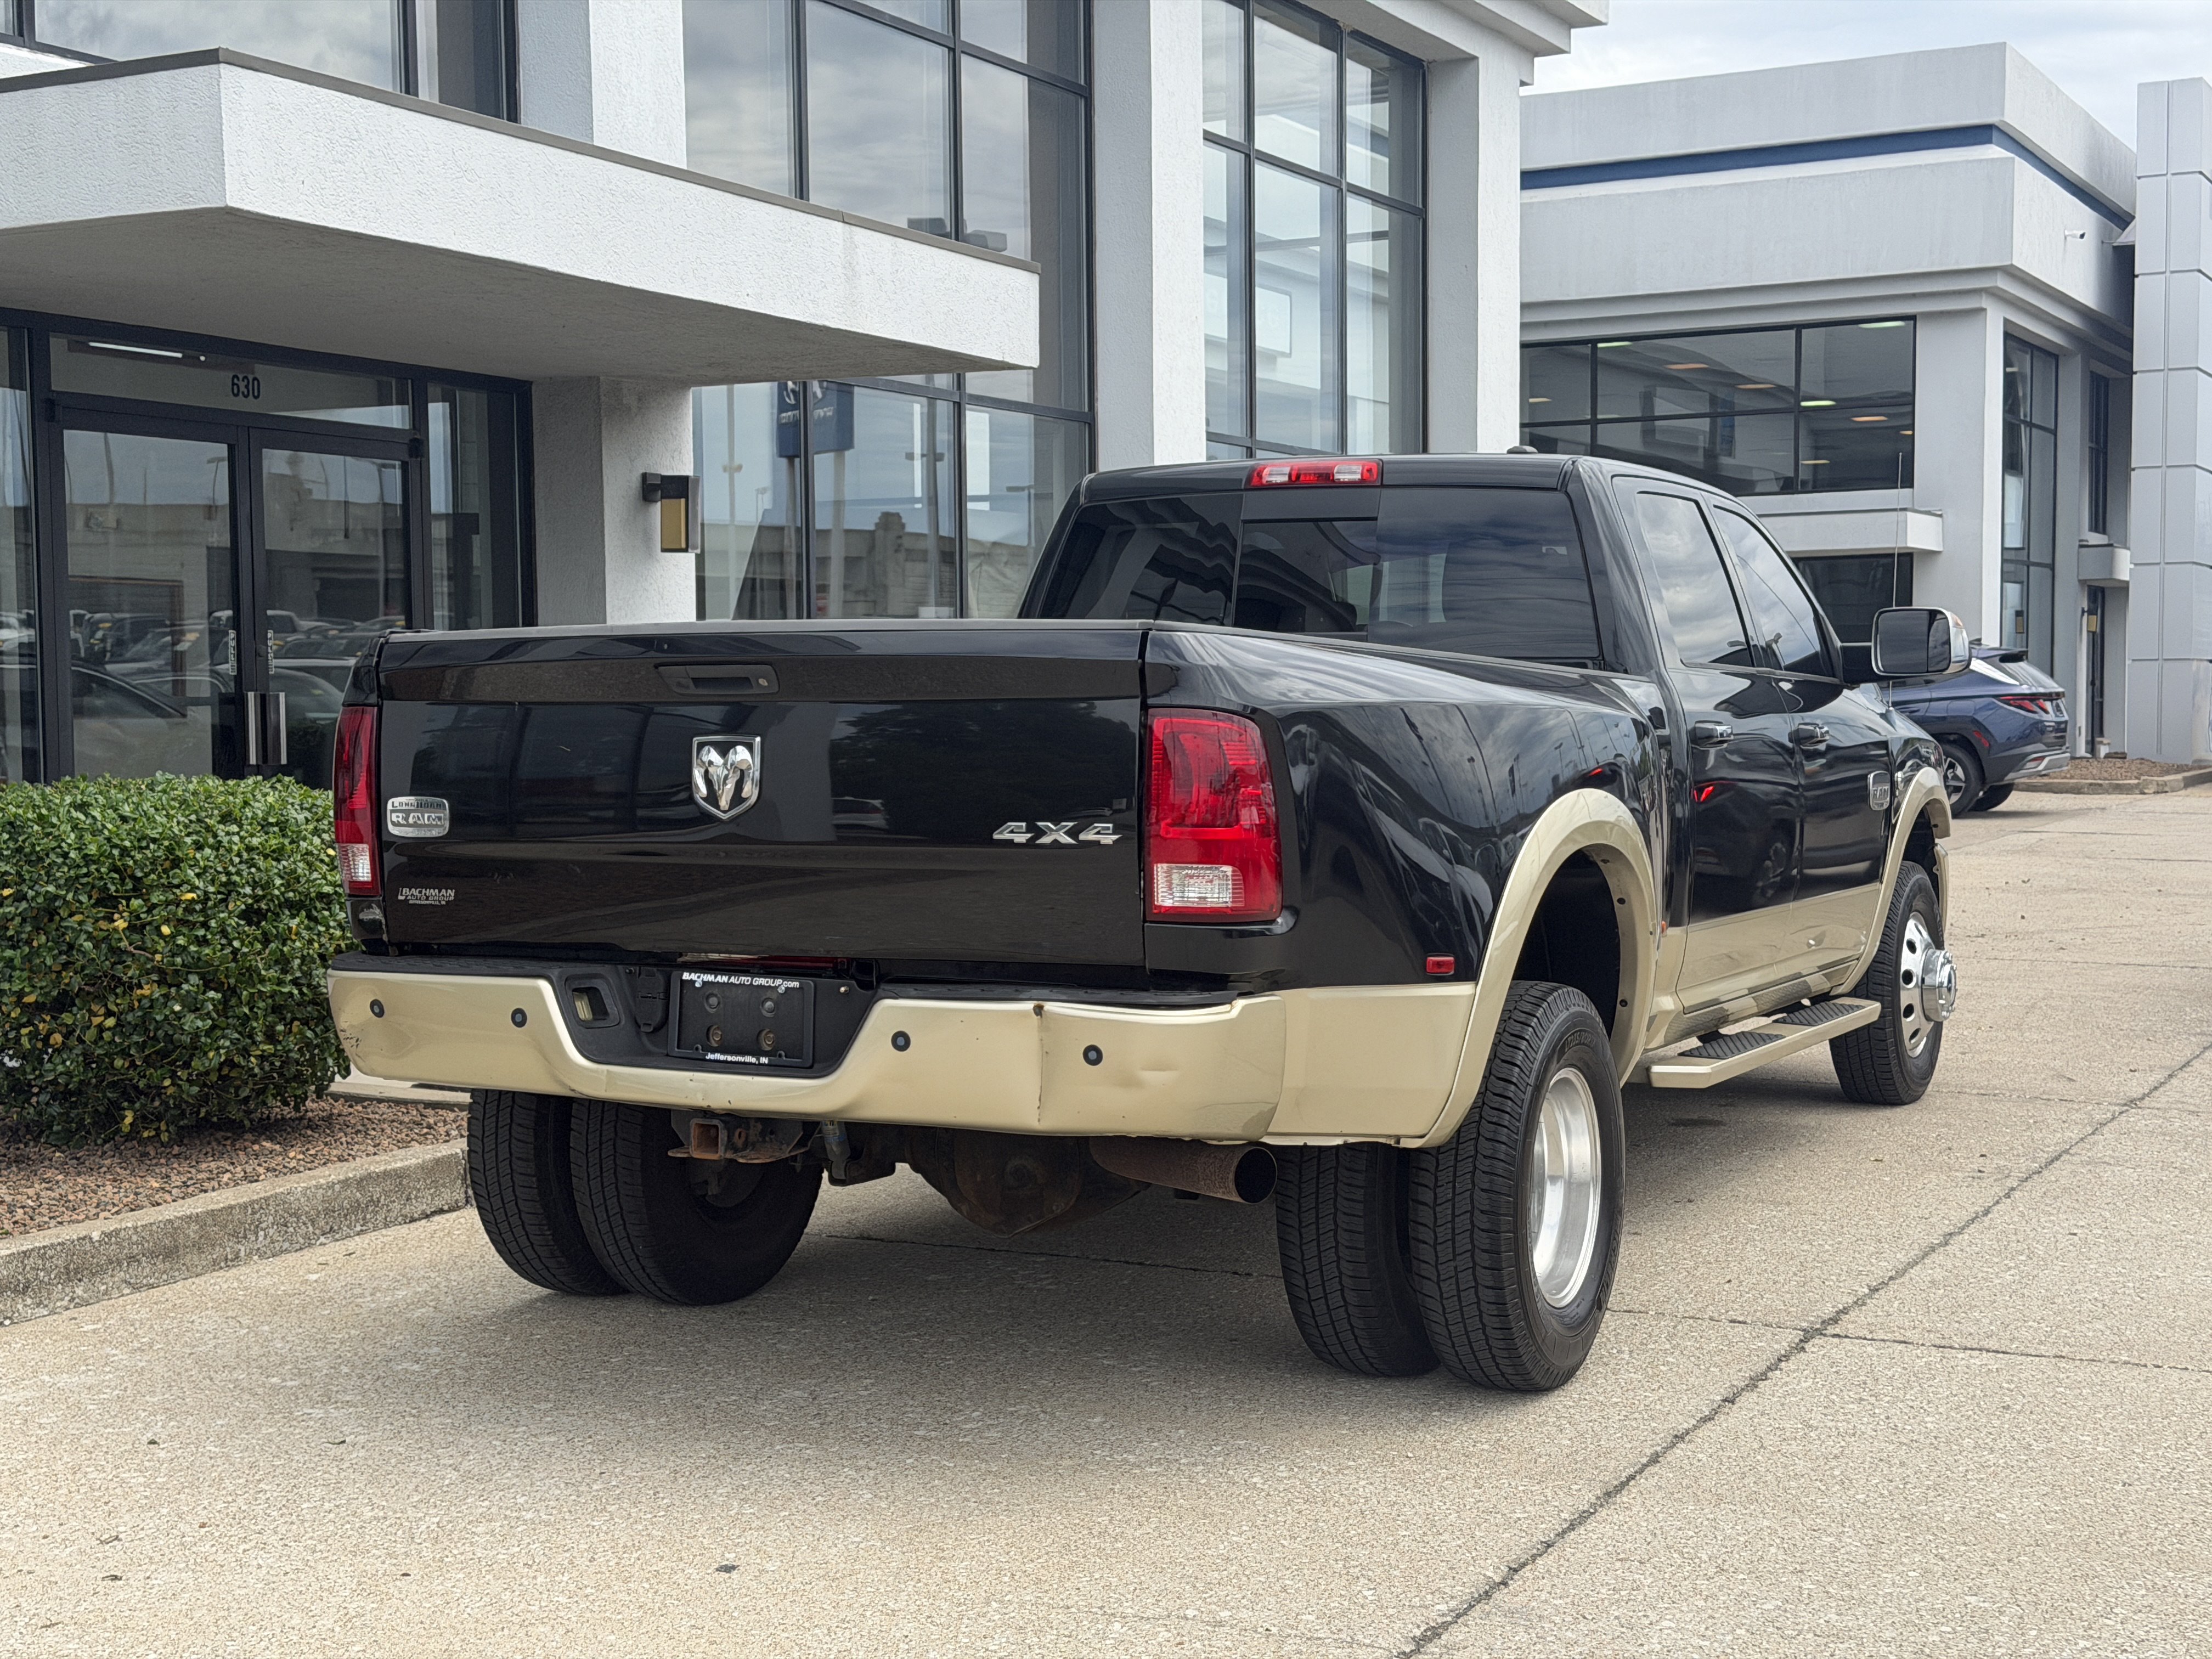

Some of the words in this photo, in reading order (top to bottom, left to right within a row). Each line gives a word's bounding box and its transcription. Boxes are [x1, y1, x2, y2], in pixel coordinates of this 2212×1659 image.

[232, 374, 261, 399] 630
[1872, 786, 1889, 799] RAM
[391, 813, 444, 825] RAM
[992, 822, 1123, 845] 4X4
[402, 888, 455, 897] BACHMAN
[682, 972, 729, 983] BACHMAN
[729, 975, 752, 985] AUTO
[706, 1052, 758, 1064] Jeffersonville,
